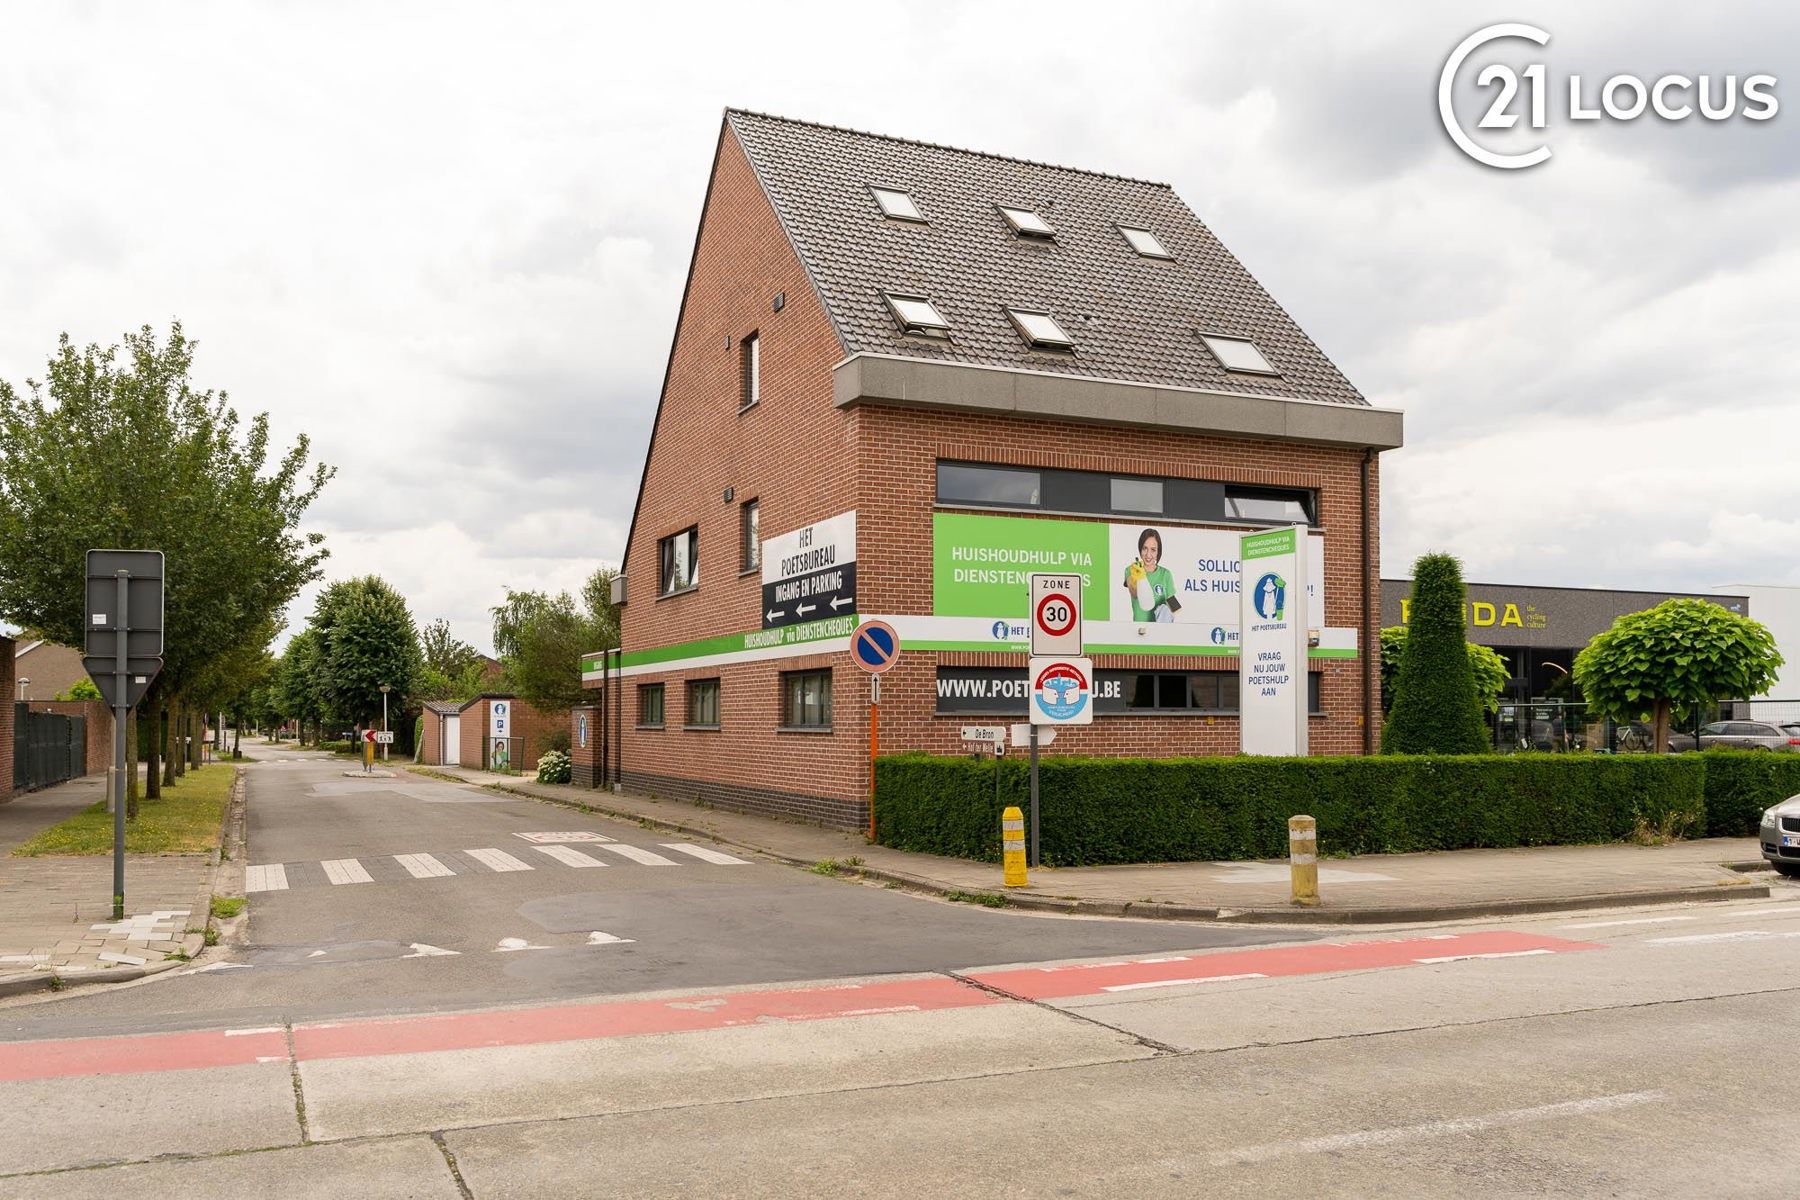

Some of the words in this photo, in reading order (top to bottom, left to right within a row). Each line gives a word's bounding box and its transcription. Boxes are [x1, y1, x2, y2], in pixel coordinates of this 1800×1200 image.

[799, 527, 814, 548] HET
[781, 544, 836, 577] POETSBUREAU
[952, 547, 1066, 565] HUISHOUDHULP
[1070, 552, 1092, 566] VIA
[1198, 559, 1240, 573] SOLLIC
[775, 581, 800, 603] INGANG
[801, 578, 810, 598] EN
[811, 570, 842, 595] PARKING
[1043, 580, 1070, 589] ZONE
[1184, 579, 1208, 592] ALS
[1212, 580, 1240, 593] HUIS
[1046, 606, 1067, 622] 30
[1526, 614, 1546, 622] cycling
[744, 629, 785, 649] HUISHOUDHULP
[786, 630, 796, 642] via
[796, 618, 853, 641] DIENSTENCHEQUES
[1011, 627, 1024, 636] HET
[1227, 632, 1239, 641] HET
[1258, 651, 1281, 661] VRAAG
[1254, 664, 1265, 673] NU
[1265, 663, 1285, 673] JOUW
[1248, 675, 1289, 685] POETSHULP
[1261, 687, 1276, 696] AAN
[975, 728, 982, 739] De
